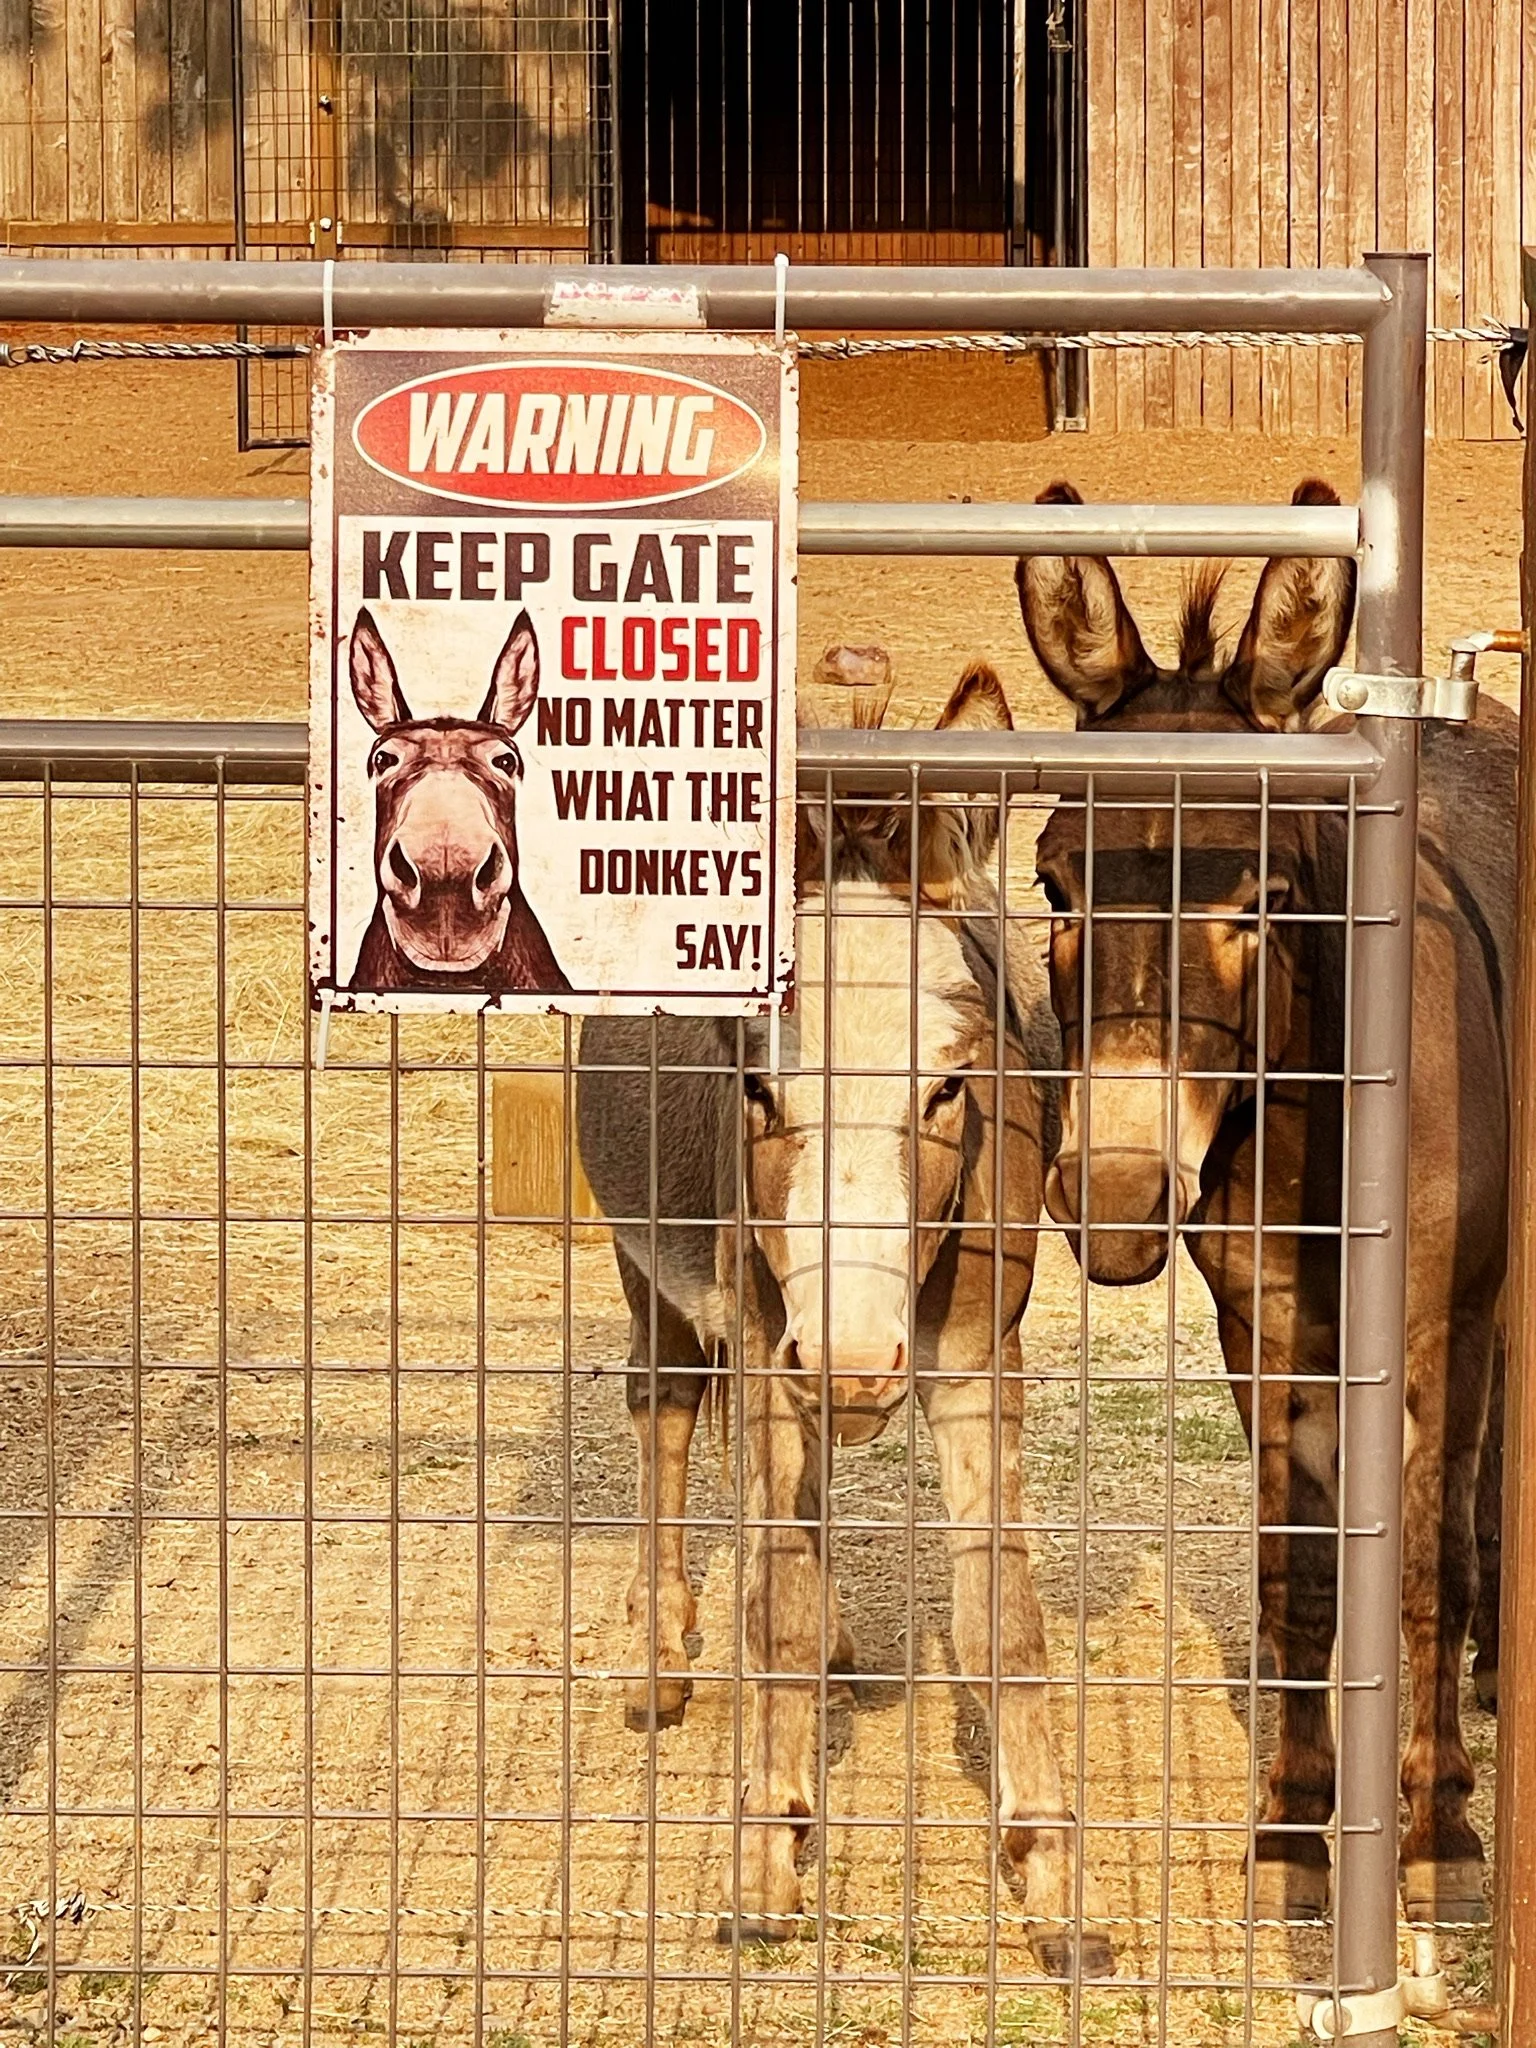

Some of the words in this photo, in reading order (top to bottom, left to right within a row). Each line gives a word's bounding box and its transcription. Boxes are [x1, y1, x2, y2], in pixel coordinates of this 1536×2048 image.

[408, 392, 715, 477] WARNING
[362, 530, 551, 600] KEEP
[572, 533, 755, 603] GATE
[561, 616, 761, 682] CLOSED
[537, 697, 591, 746] NO
[603, 697, 763, 748] MATTER
[551, 769, 674, 821] WHAT
[686, 771, 763, 822] THE
[580, 848, 762, 897] DONKEYS
[676, 923, 762, 972] SAY!
